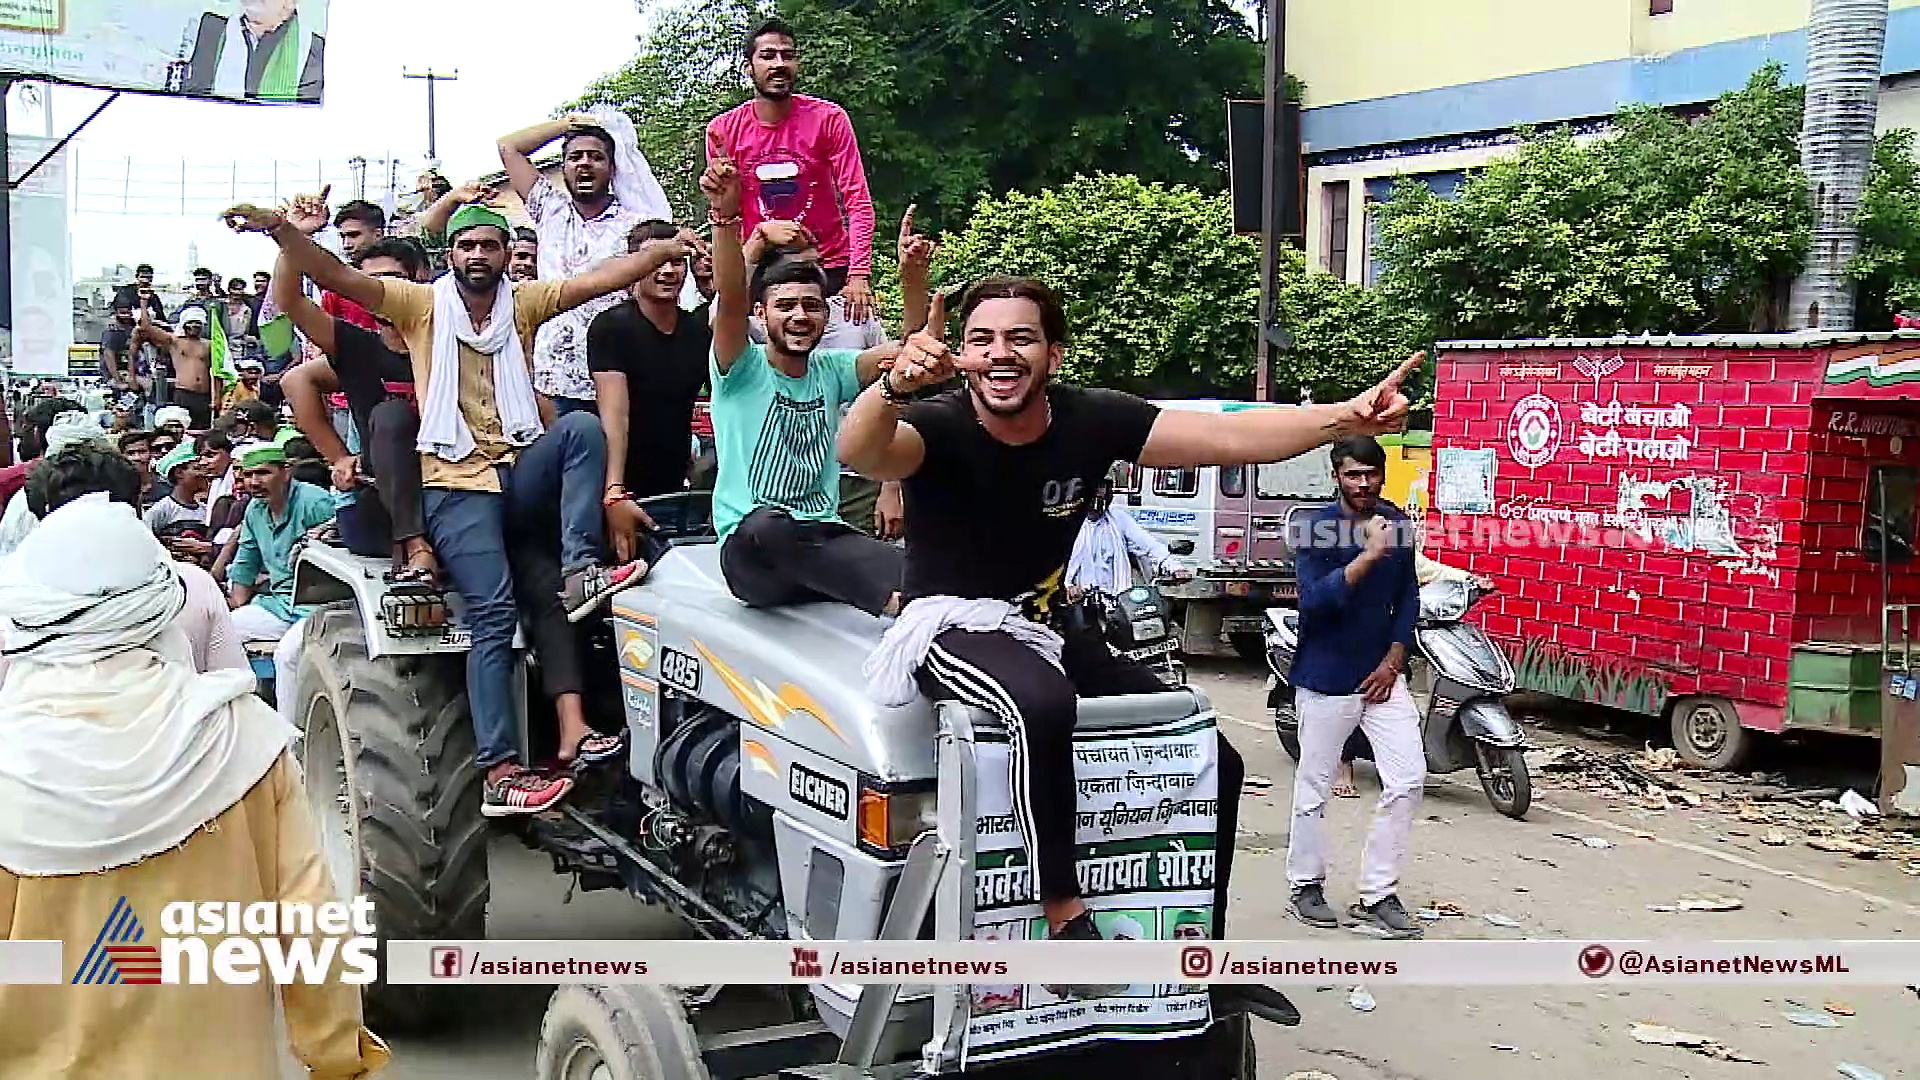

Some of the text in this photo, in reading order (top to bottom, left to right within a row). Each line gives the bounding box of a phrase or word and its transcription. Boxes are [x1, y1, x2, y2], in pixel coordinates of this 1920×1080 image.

[1580, 401, 1623, 425] बेटी
[1624, 402, 1692, 426] बचाओ
[1578, 430, 1621, 457] बेटी
[662, 650, 698, 688] 485
[791, 768, 847, 814] EICHER
[1076, 777, 1123, 800] एकता
[1099, 802, 1155, 835] यूनियन
